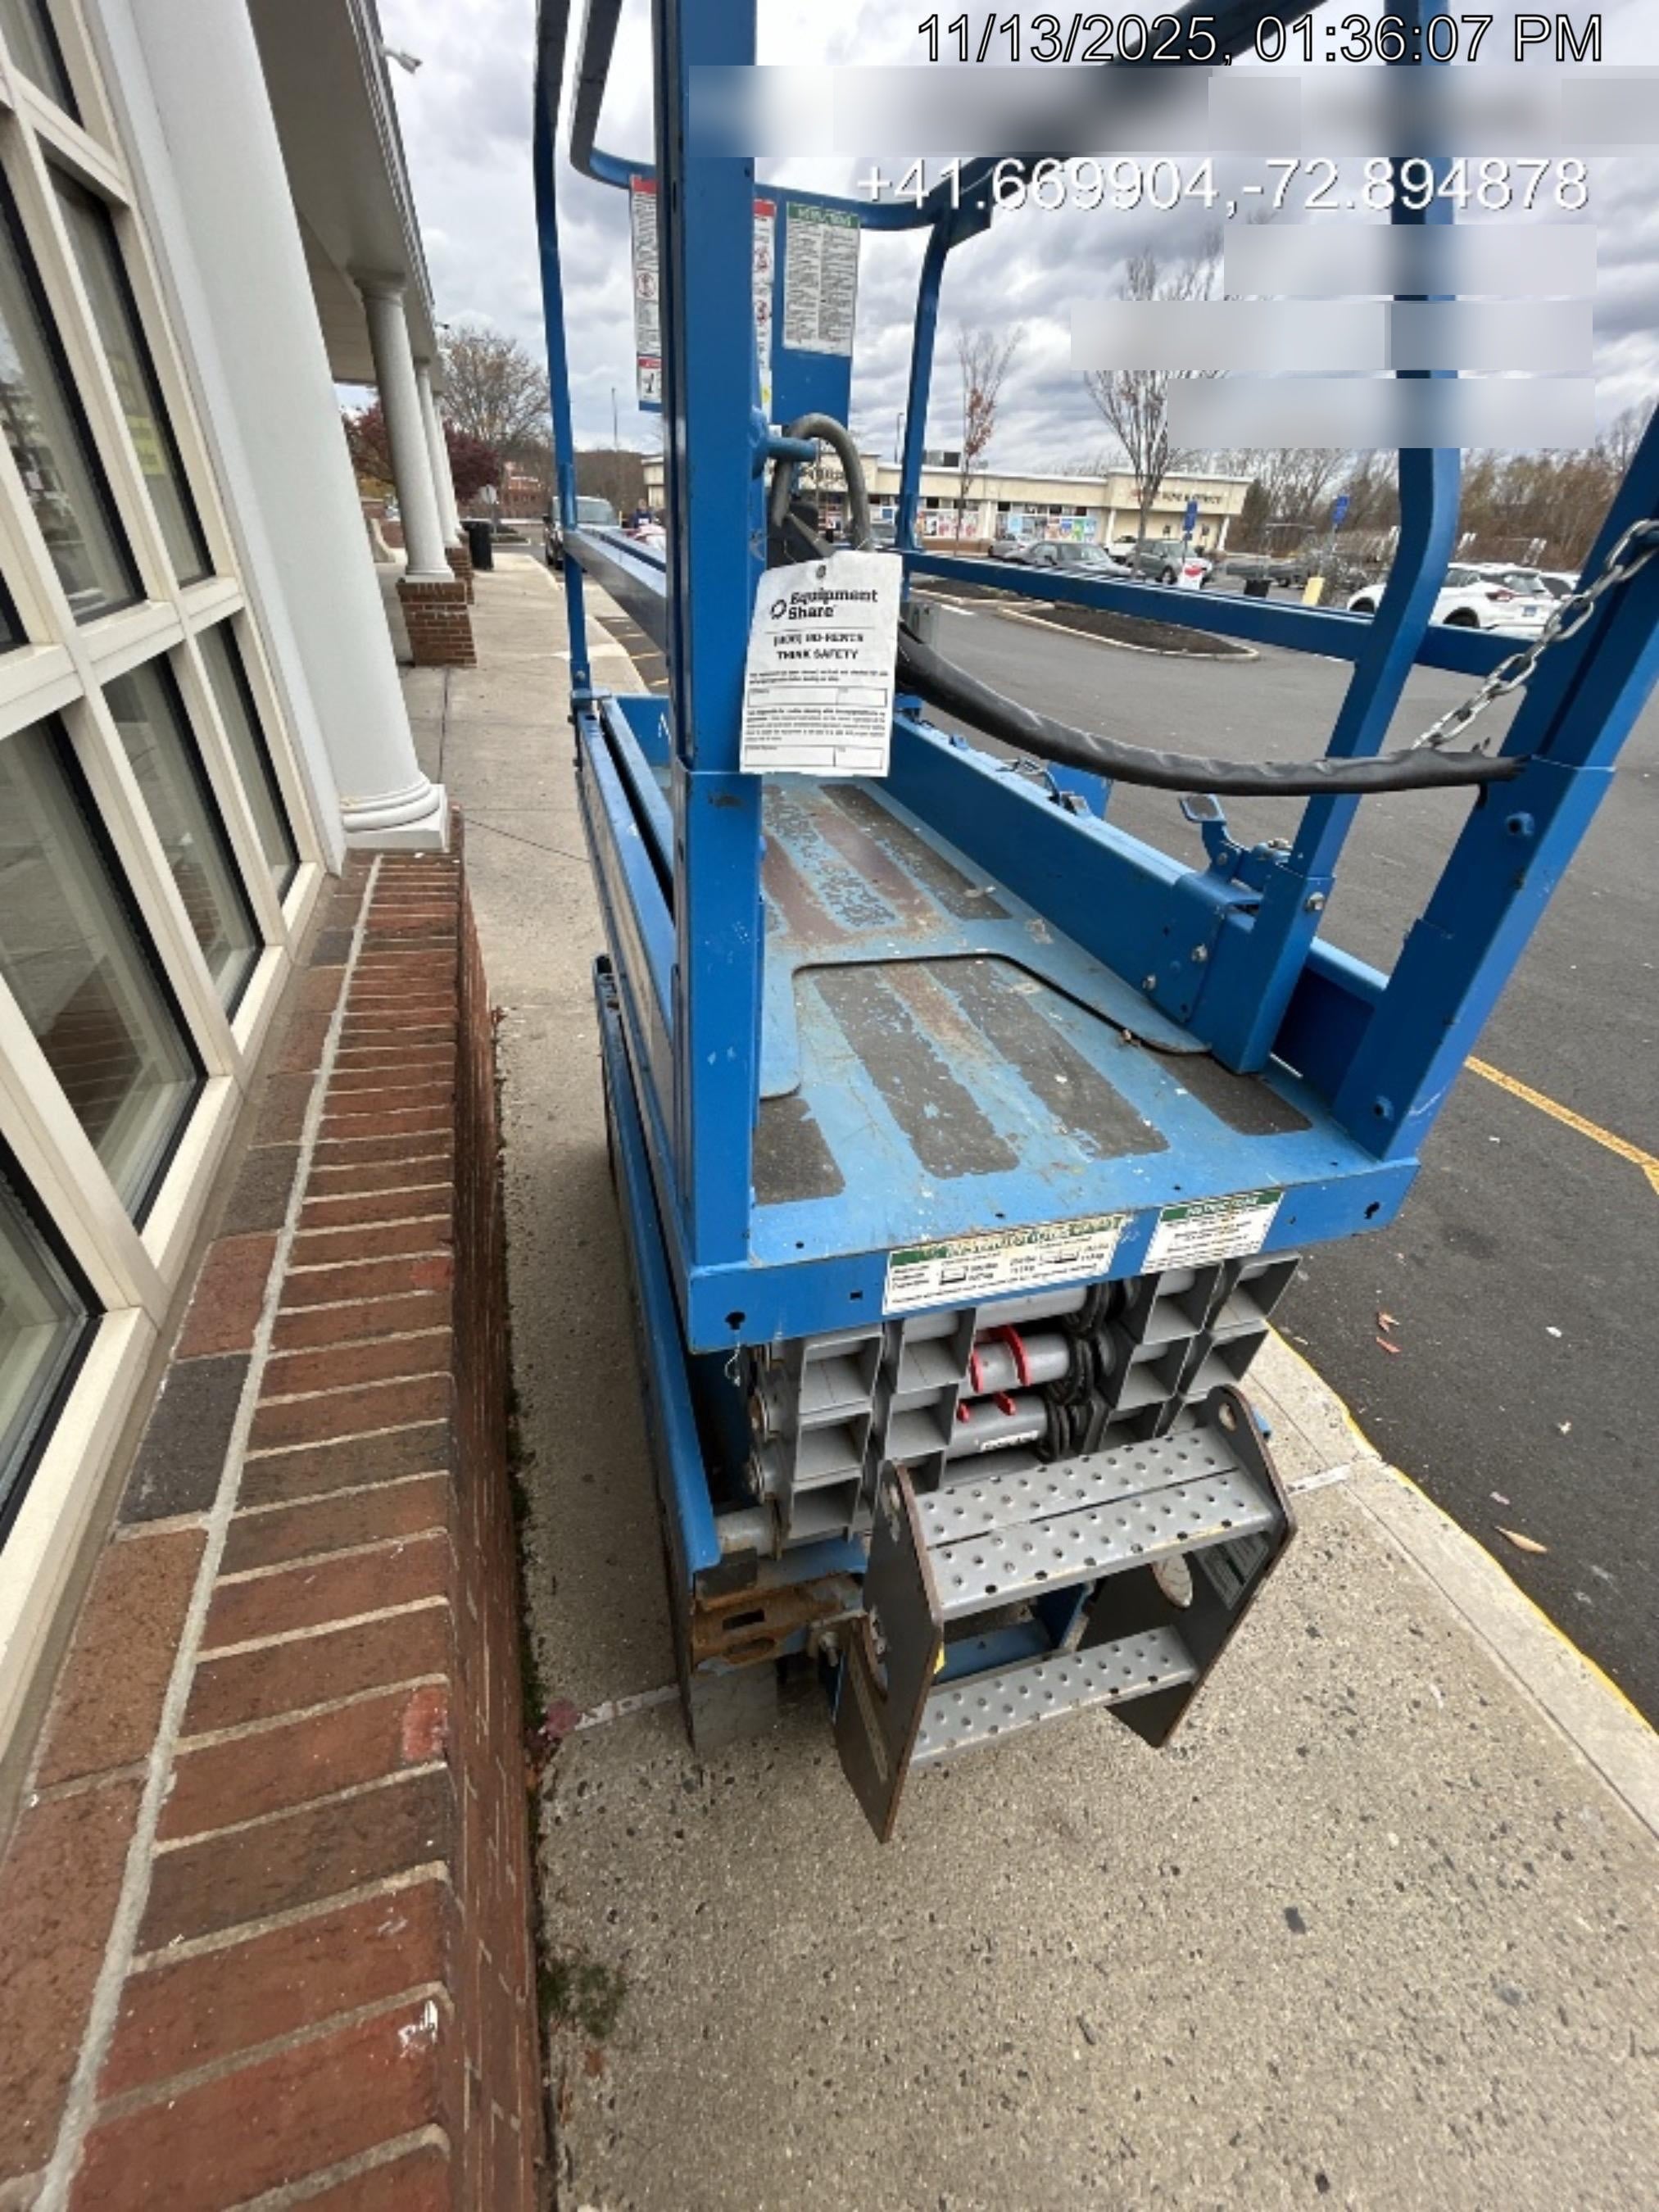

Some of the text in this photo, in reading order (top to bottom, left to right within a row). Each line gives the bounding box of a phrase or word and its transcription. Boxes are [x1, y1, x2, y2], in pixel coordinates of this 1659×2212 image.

[790, 587, 878, 605] Equipment
[788, 606, 834, 619] Share
[813, 648, 859, 660] SAFETY
